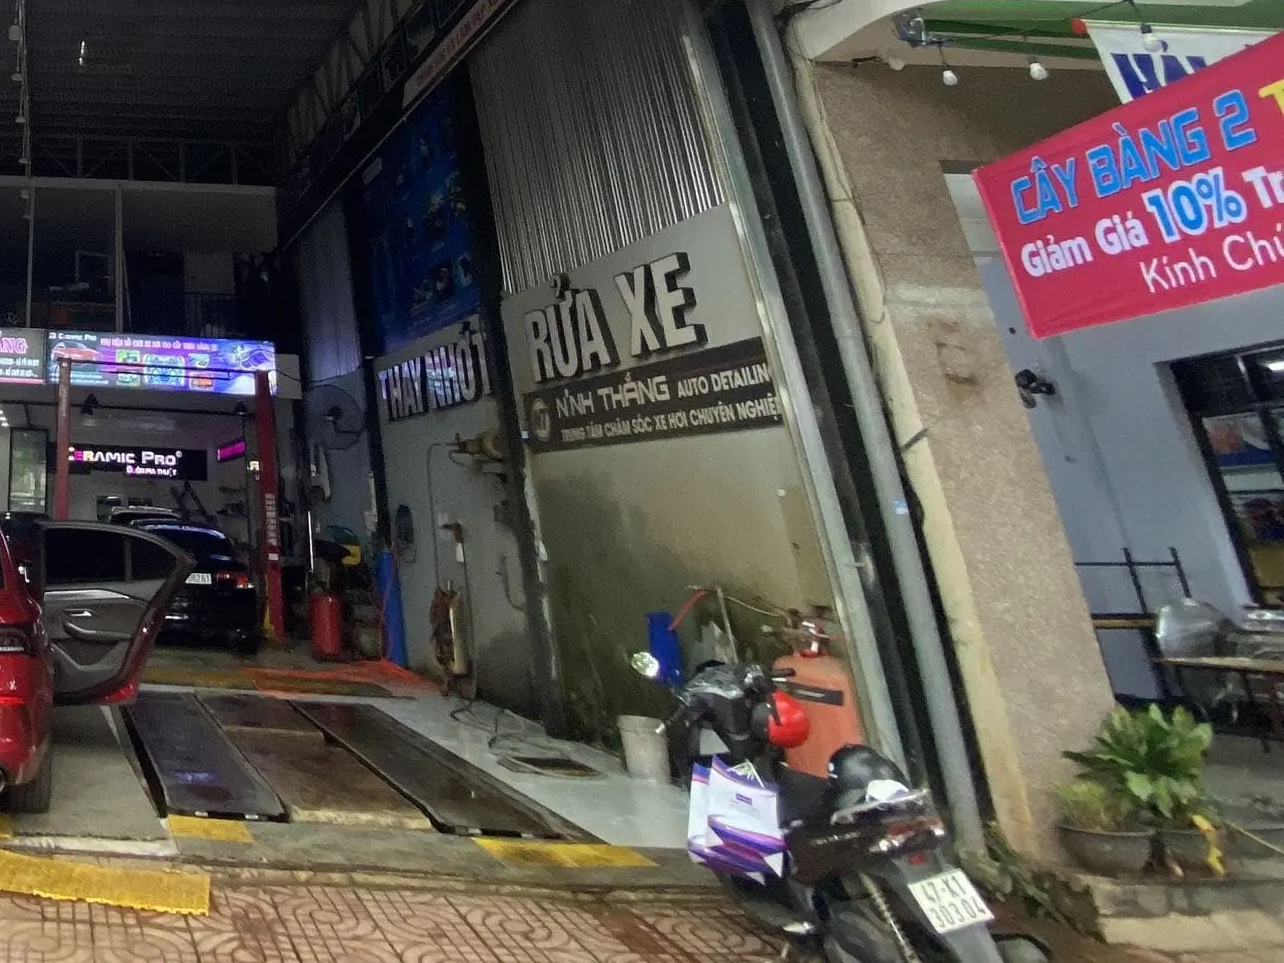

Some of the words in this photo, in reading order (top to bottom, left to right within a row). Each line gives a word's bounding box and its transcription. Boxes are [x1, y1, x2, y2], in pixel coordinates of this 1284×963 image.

[1010, 156, 1079, 225] CÂY
[1085, 118, 1212, 199] BÀNG
[1212, 89, 1258, 151] 2
[1020, 234, 1093, 278] Giảm
[1094, 210, 1149, 256] Giá
[1141, 166, 1248, 245] 10%
[1139, 248, 1218, 294] Kính
[524, 273, 612, 384] RỬA
[615, 252, 702, 357] XE
[676, 374, 710, 399] AUTO
[709, 363, 775, 392] DETAILIN
[604, 418, 632, 439] CHĂM
[631, 413, 654, 435] SÓC
[653, 414, 668, 431] XE
[667, 413, 689, 429] HƠI
[689, 399, 737, 425] CHUYÊN
[141, 450, 177, 466] PRO
